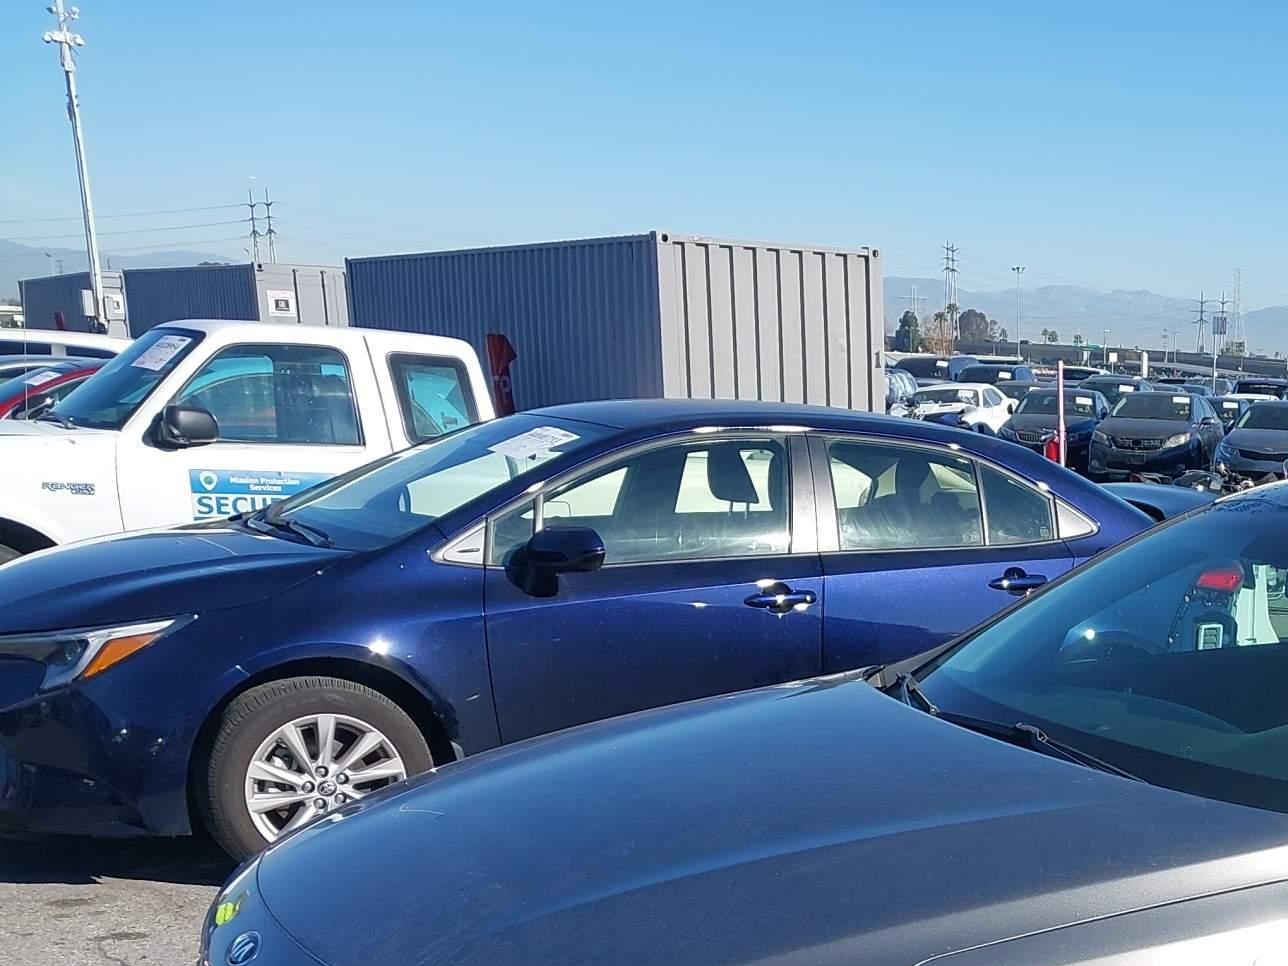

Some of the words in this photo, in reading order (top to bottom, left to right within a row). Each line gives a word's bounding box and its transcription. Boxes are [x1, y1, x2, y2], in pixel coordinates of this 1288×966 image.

[229, 477, 259, 485] Mission
[260, 478, 300, 486] Protection
[197, 495, 283, 515] SECU
